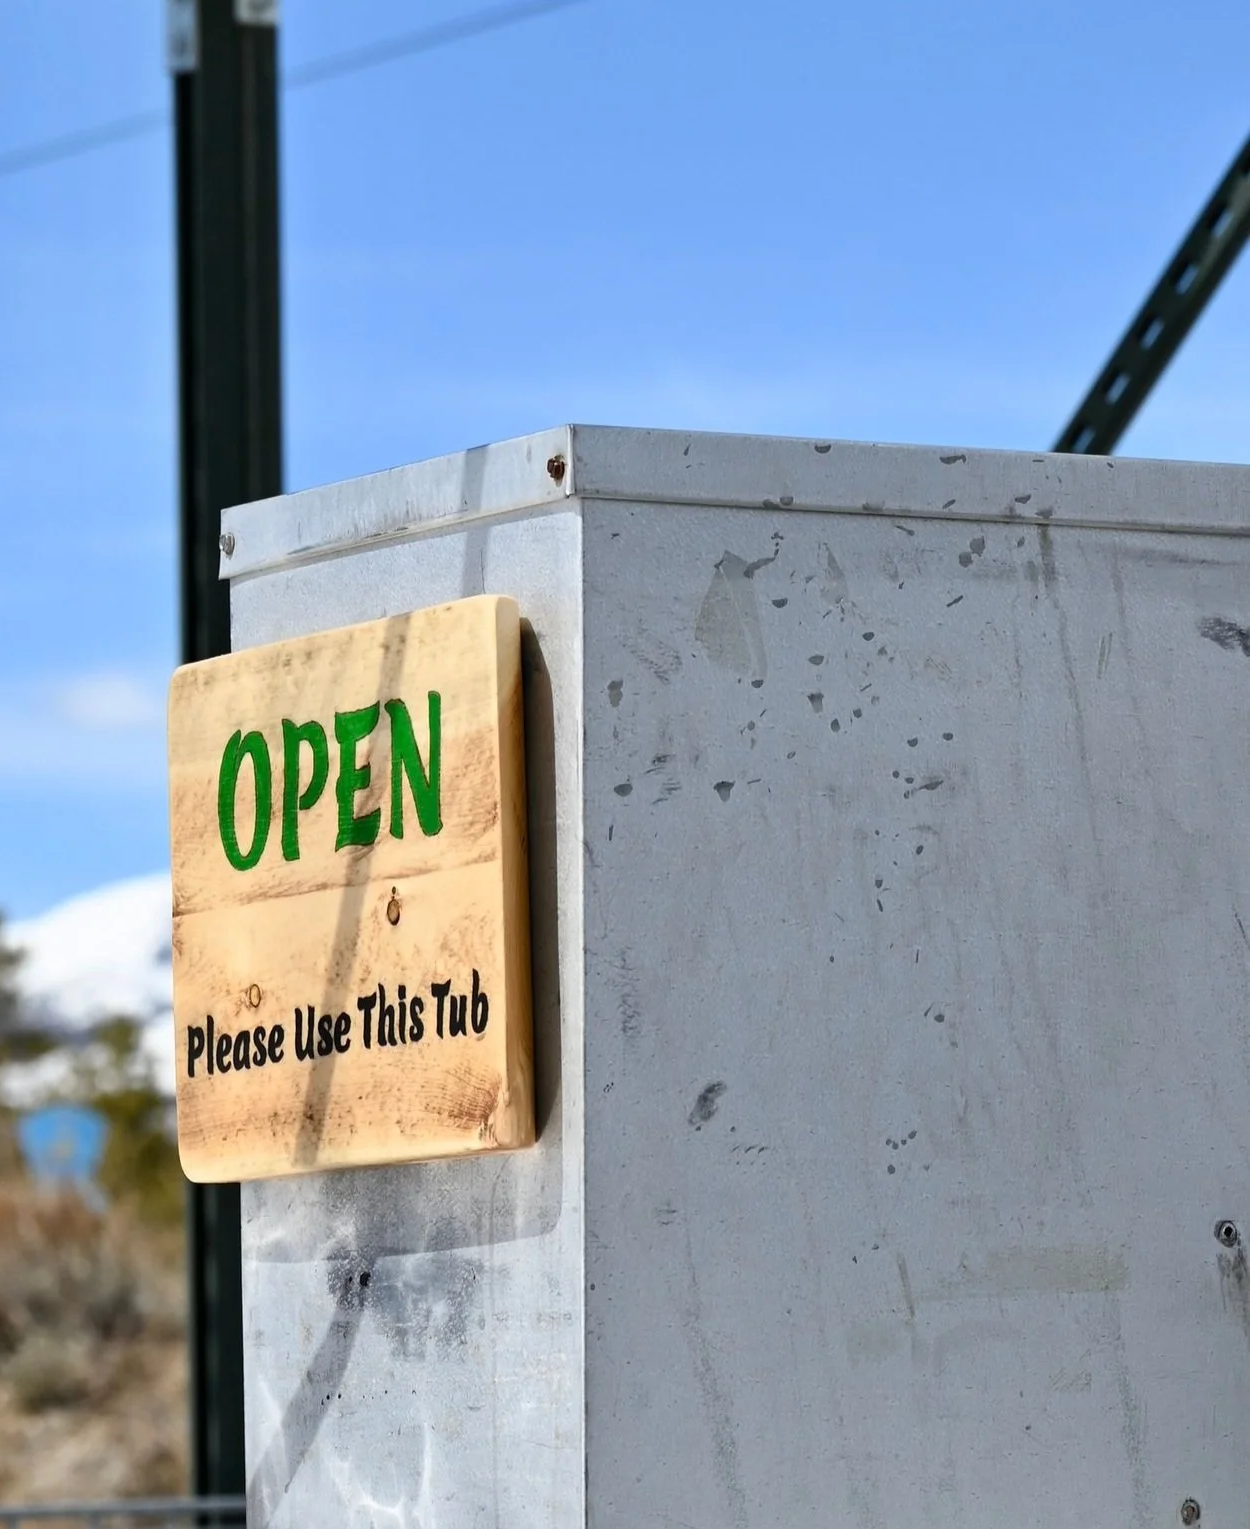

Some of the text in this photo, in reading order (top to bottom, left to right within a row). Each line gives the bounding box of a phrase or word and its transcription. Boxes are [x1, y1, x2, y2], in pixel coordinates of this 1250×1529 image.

[218, 690, 442, 871] OPEN
[187, 969, 488, 1077] Please Use This Tub
